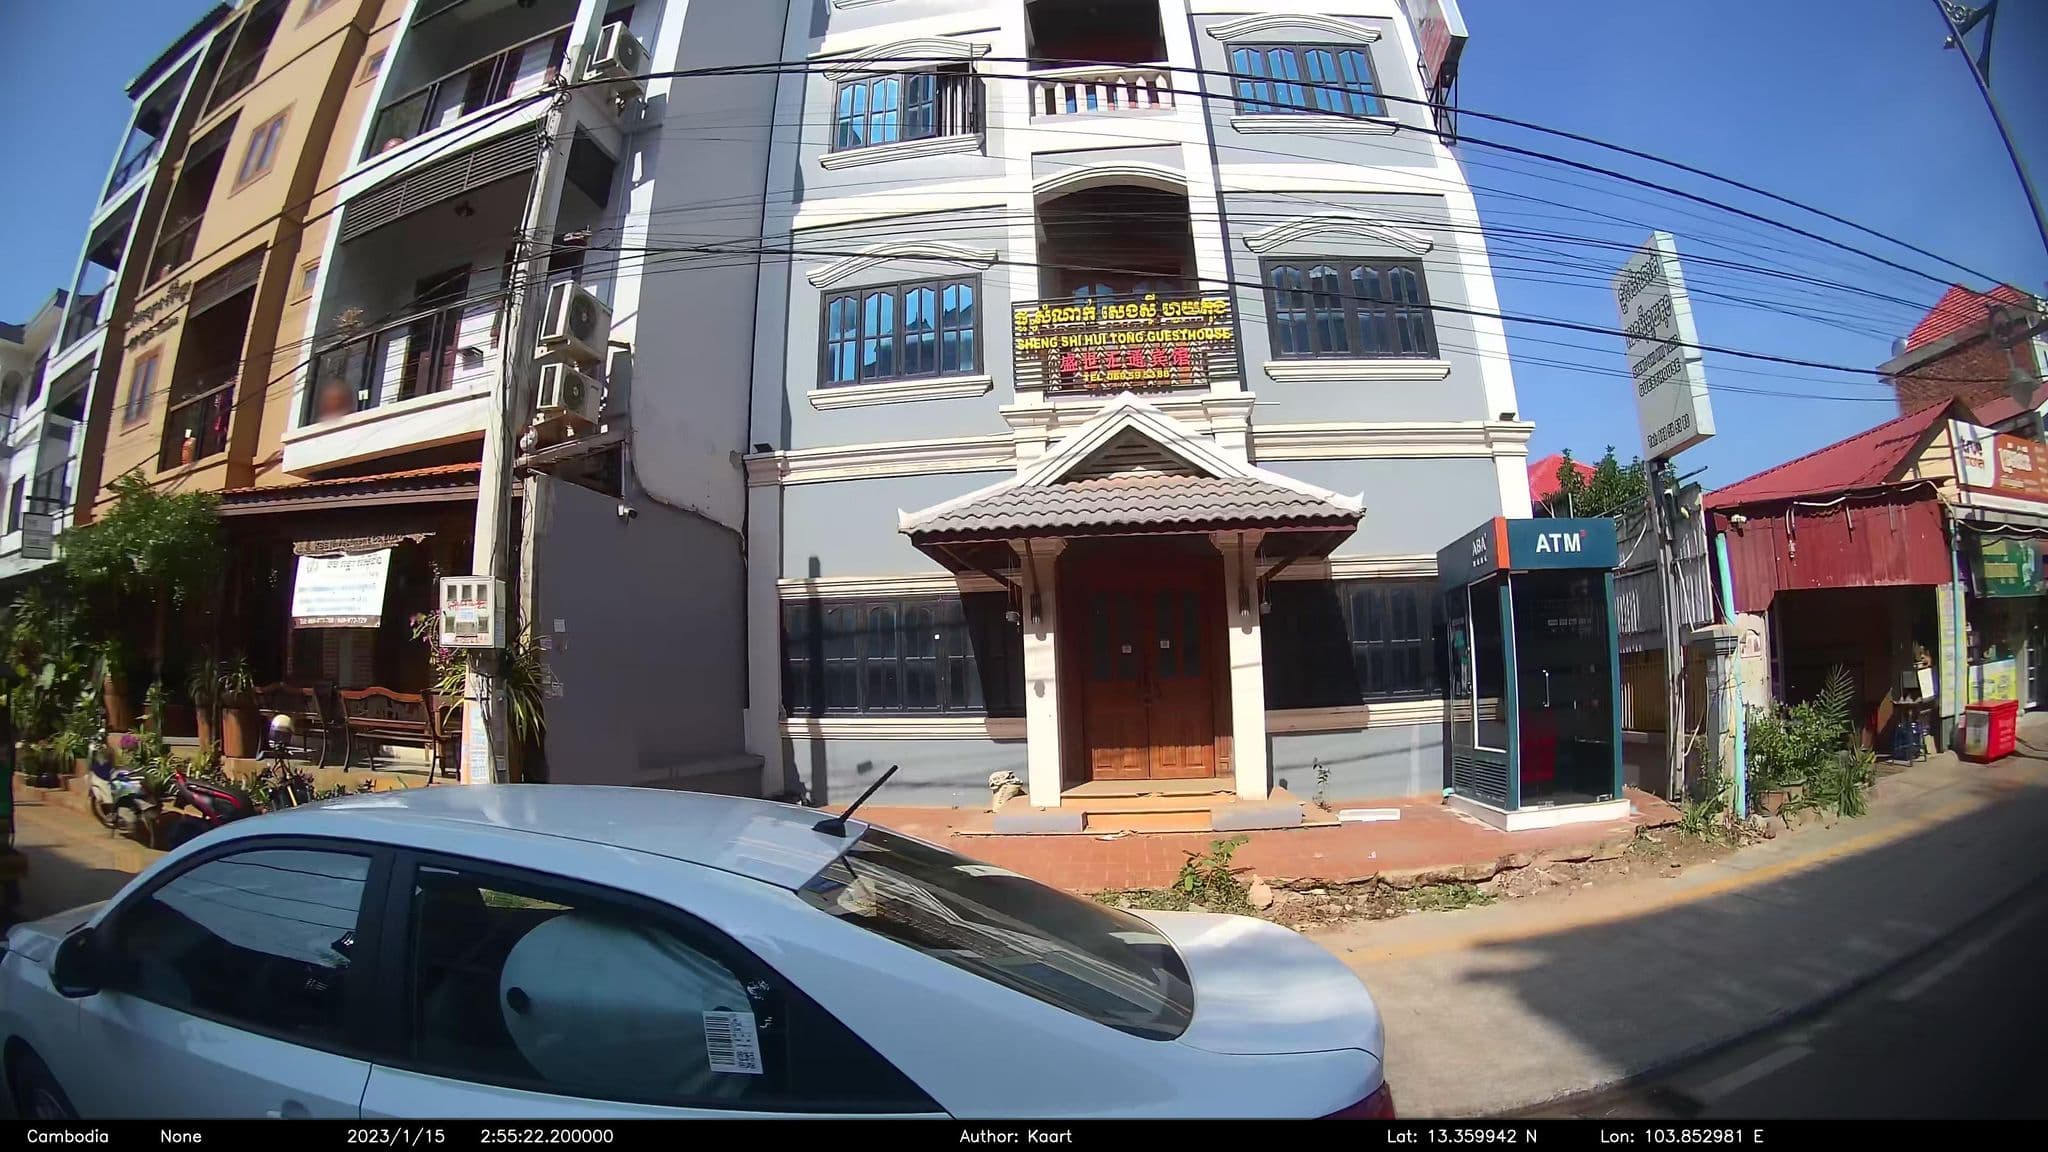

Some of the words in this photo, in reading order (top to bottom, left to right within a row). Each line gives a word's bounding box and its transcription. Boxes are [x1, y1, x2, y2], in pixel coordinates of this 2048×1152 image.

[1016, 336, 1058, 350] SHENG
[1061, 334, 1081, 347] SHI
[1084, 332, 1108, 346] HUI
[1110, 330, 1144, 345] TONG
[1147, 328, 1231, 343] GUESTHOUSE
[1535, 532, 1582, 553] ATM
